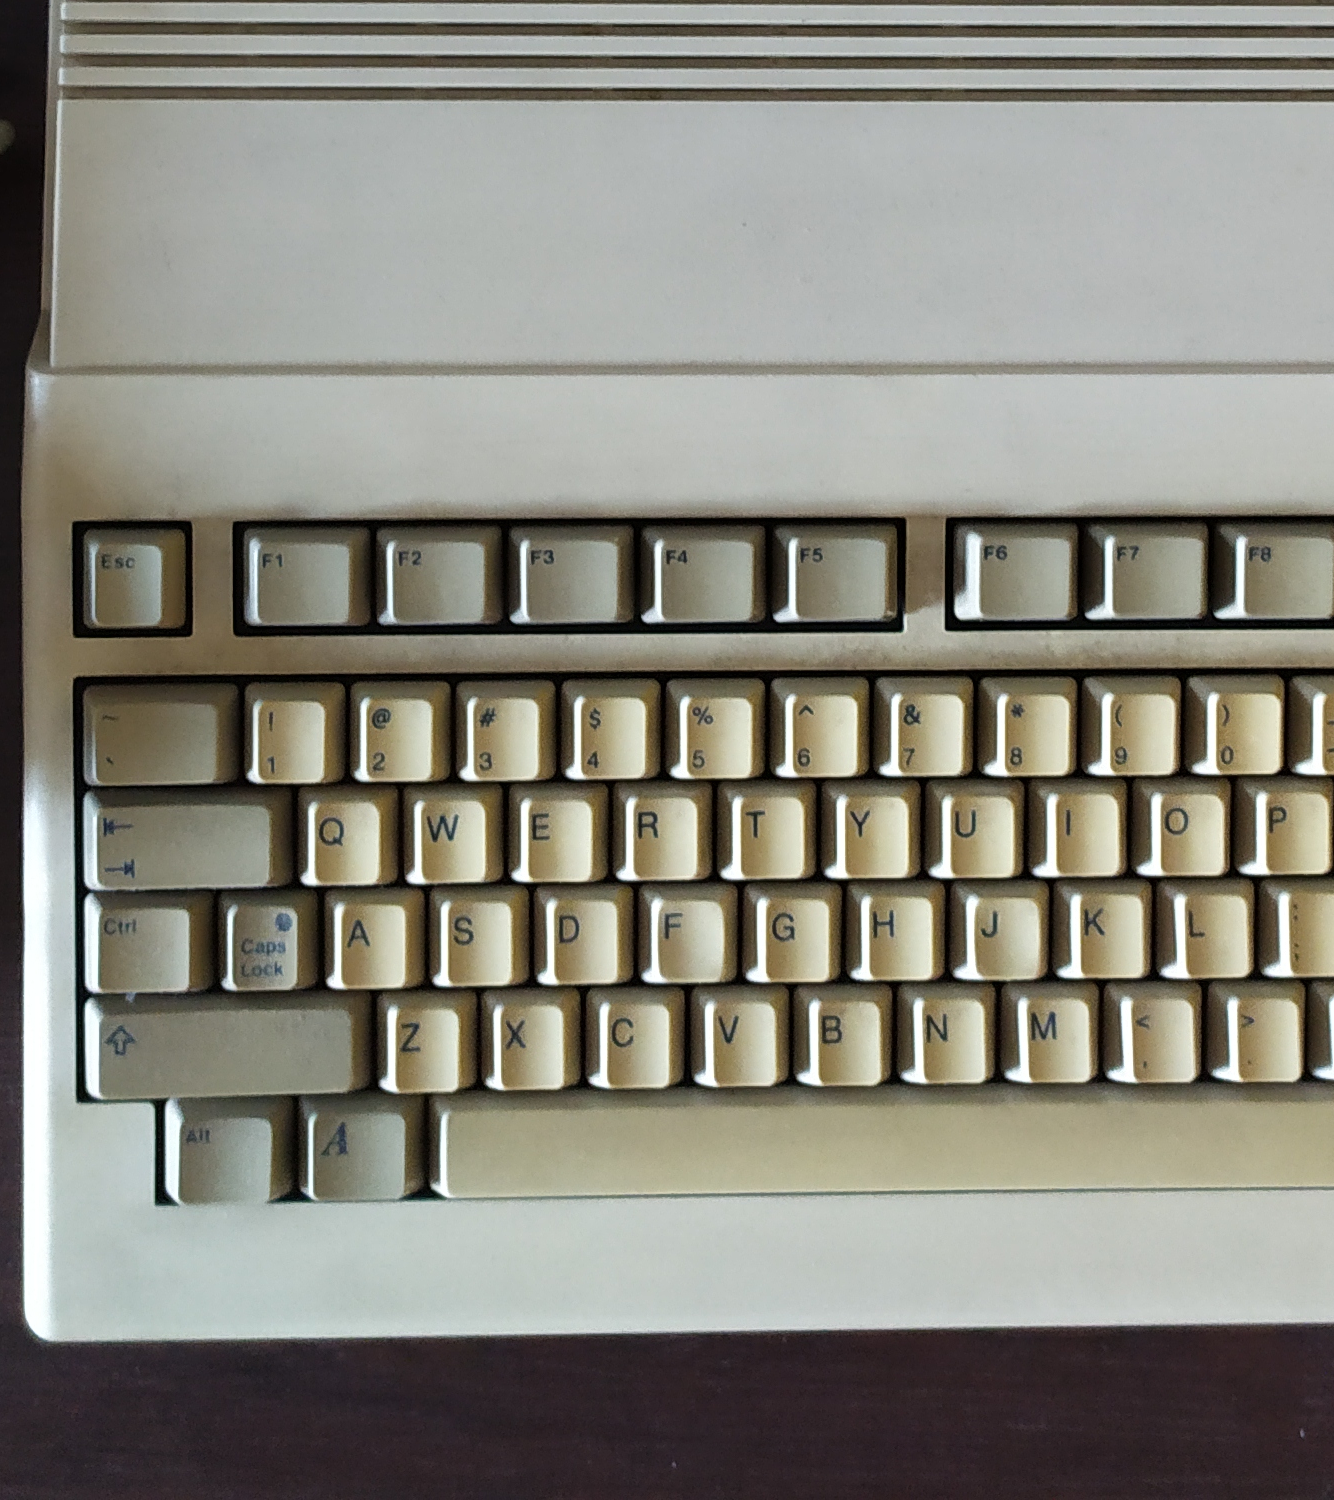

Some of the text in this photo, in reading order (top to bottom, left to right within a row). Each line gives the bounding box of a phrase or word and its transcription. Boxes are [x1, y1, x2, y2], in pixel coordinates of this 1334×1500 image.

[101, 554, 134, 569] Esc
[262, 553, 282, 568] F1
[398, 551, 421, 566] F2
[530, 550, 554, 565] F3
[666, 550, 687, 565] F4
[800, 548, 823, 563] F5
[983, 545, 1007, 560] F6
[1116, 546, 1139, 561] F7
[1248, 546, 1271, 562] F8
[372, 708, 391, 729] @
[479, 708, 496, 727] #
[589, 708, 601, 730] $
[692, 706, 713, 725] %
[798, 705, 813, 716] ^
[903, 704, 920, 725] &
[1115, 704, 1122, 727] (
[1222, 703, 1230, 727] )
[268, 757, 275, 774] 1
[372, 752, 385, 772] 2
[479, 752, 492, 771] 3
[587, 751, 599, 768] 4
[692, 750, 705, 769] 5
[797, 748, 810, 767] 6
[903, 748, 915, 768] 7
[1010, 747, 1022, 767] 8
[1114, 746, 1127, 765] 9
[1219, 746, 1234, 765] 0
[427, 815, 458, 842] W
[531, 814, 550, 841] E
[637, 812, 658, 839] R
[745, 811, 765, 838] T
[850, 810, 870, 837] Y
[954, 810, 976, 838] U
[1066, 810, 1071, 836] I
[1163, 808, 1189, 835] O
[1268, 806, 1286, 834] P
[318, 818, 344, 846] Q
[101, 918, 136, 936] Ctrl
[454, 916, 474, 945] S
[558, 915, 579, 944] D
[664, 913, 682, 939] F
[772, 913, 795, 942] G
[872, 910, 894, 939] H
[981, 911, 998, 938] J
[1083, 909, 1105, 936] K
[1188, 909, 1205, 938] L
[347, 920, 370, 948] A
[240, 938, 285, 956] Caps
[240, 962, 282, 978] Lock
[718, 1016, 739, 1044] V
[821, 1015, 842, 1045] B
[925, 1014, 948, 1043] N
[1030, 1012, 1056, 1041] M
[1136, 1014, 1150, 1029] <
[400, 1023, 420, 1053] Z
[505, 1020, 526, 1050] X
[610, 1018, 633, 1048] C
